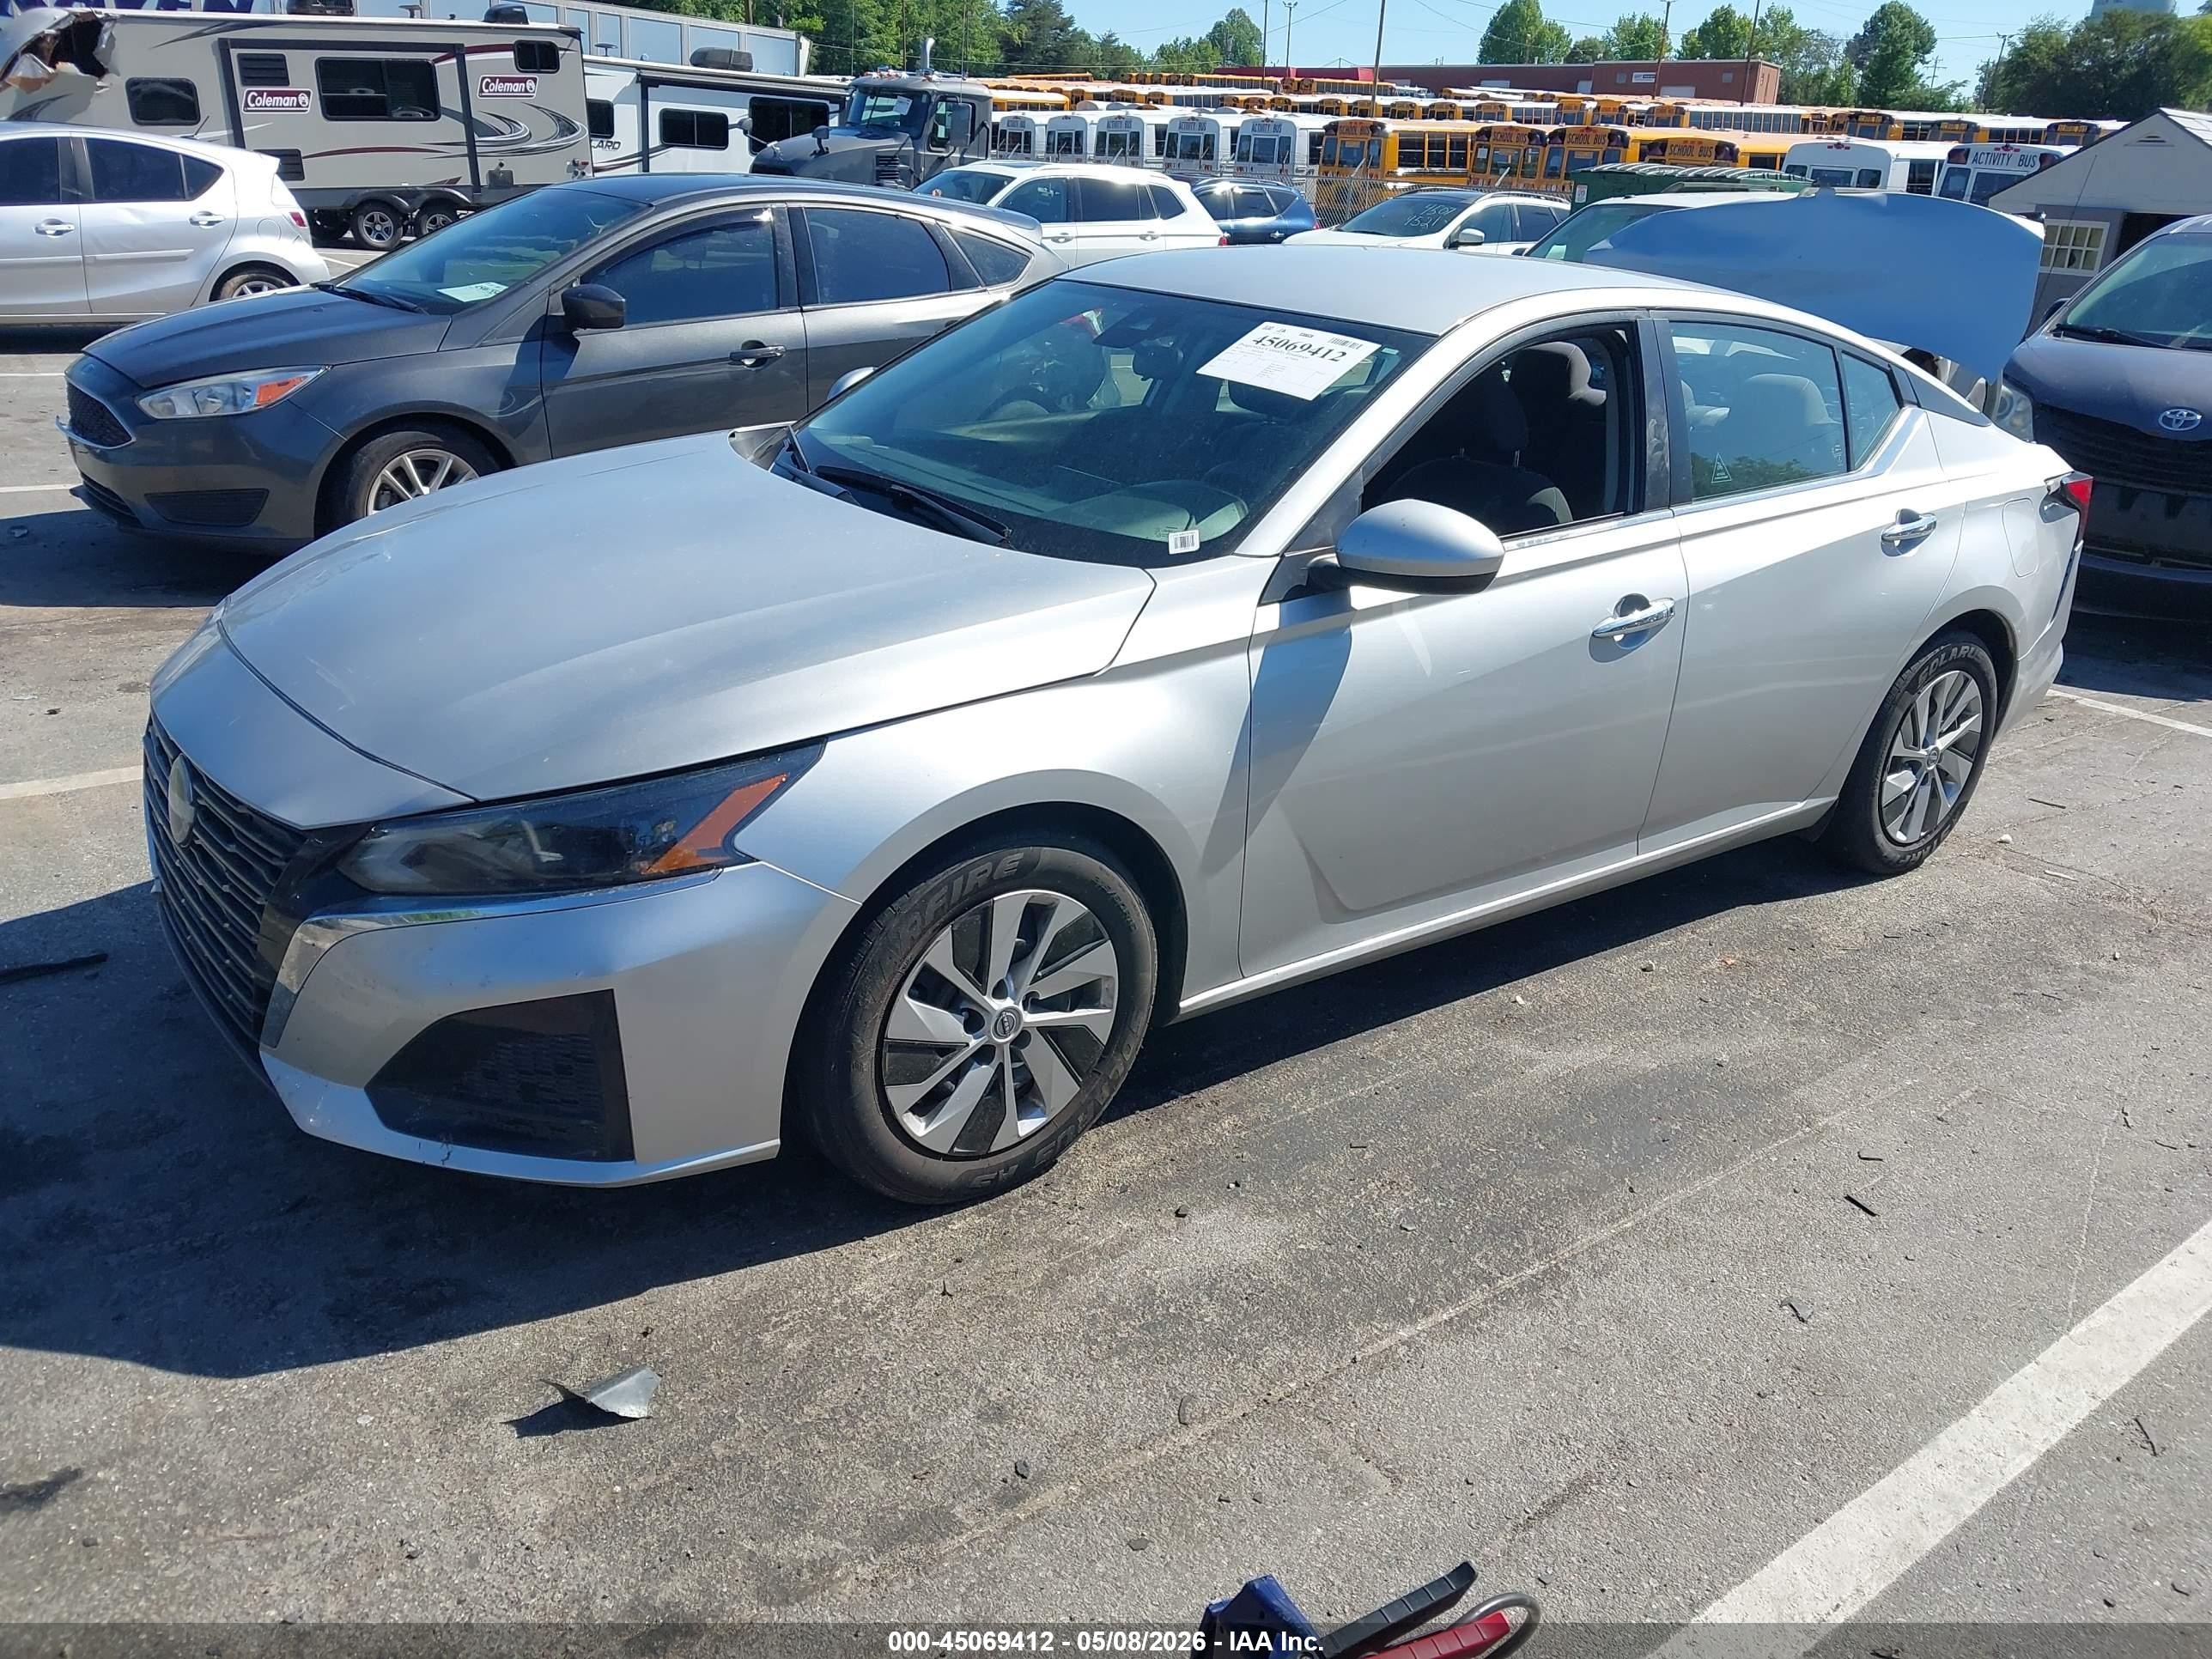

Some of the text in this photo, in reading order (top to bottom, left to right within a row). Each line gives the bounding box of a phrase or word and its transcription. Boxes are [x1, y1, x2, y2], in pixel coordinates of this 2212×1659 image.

[482, 78, 526, 93] Coleman
[247, 92, 297, 107] Coleman
[1178, 121, 1206, 131] ACTIVITY BUS
[1251, 123, 1282, 133] ACTIVITY BUS
[1492, 131, 1528, 143] SCHOOL BUS
[1566, 132, 1607, 144] SCHOOL BUS
[1668, 143, 1714, 158] SCHOOL BUS
[1972, 152, 2038, 167] ACTIVITY BUS
[1252, 335, 1347, 362] 45069412
[1917, 645, 1984, 684] SOLARUS
